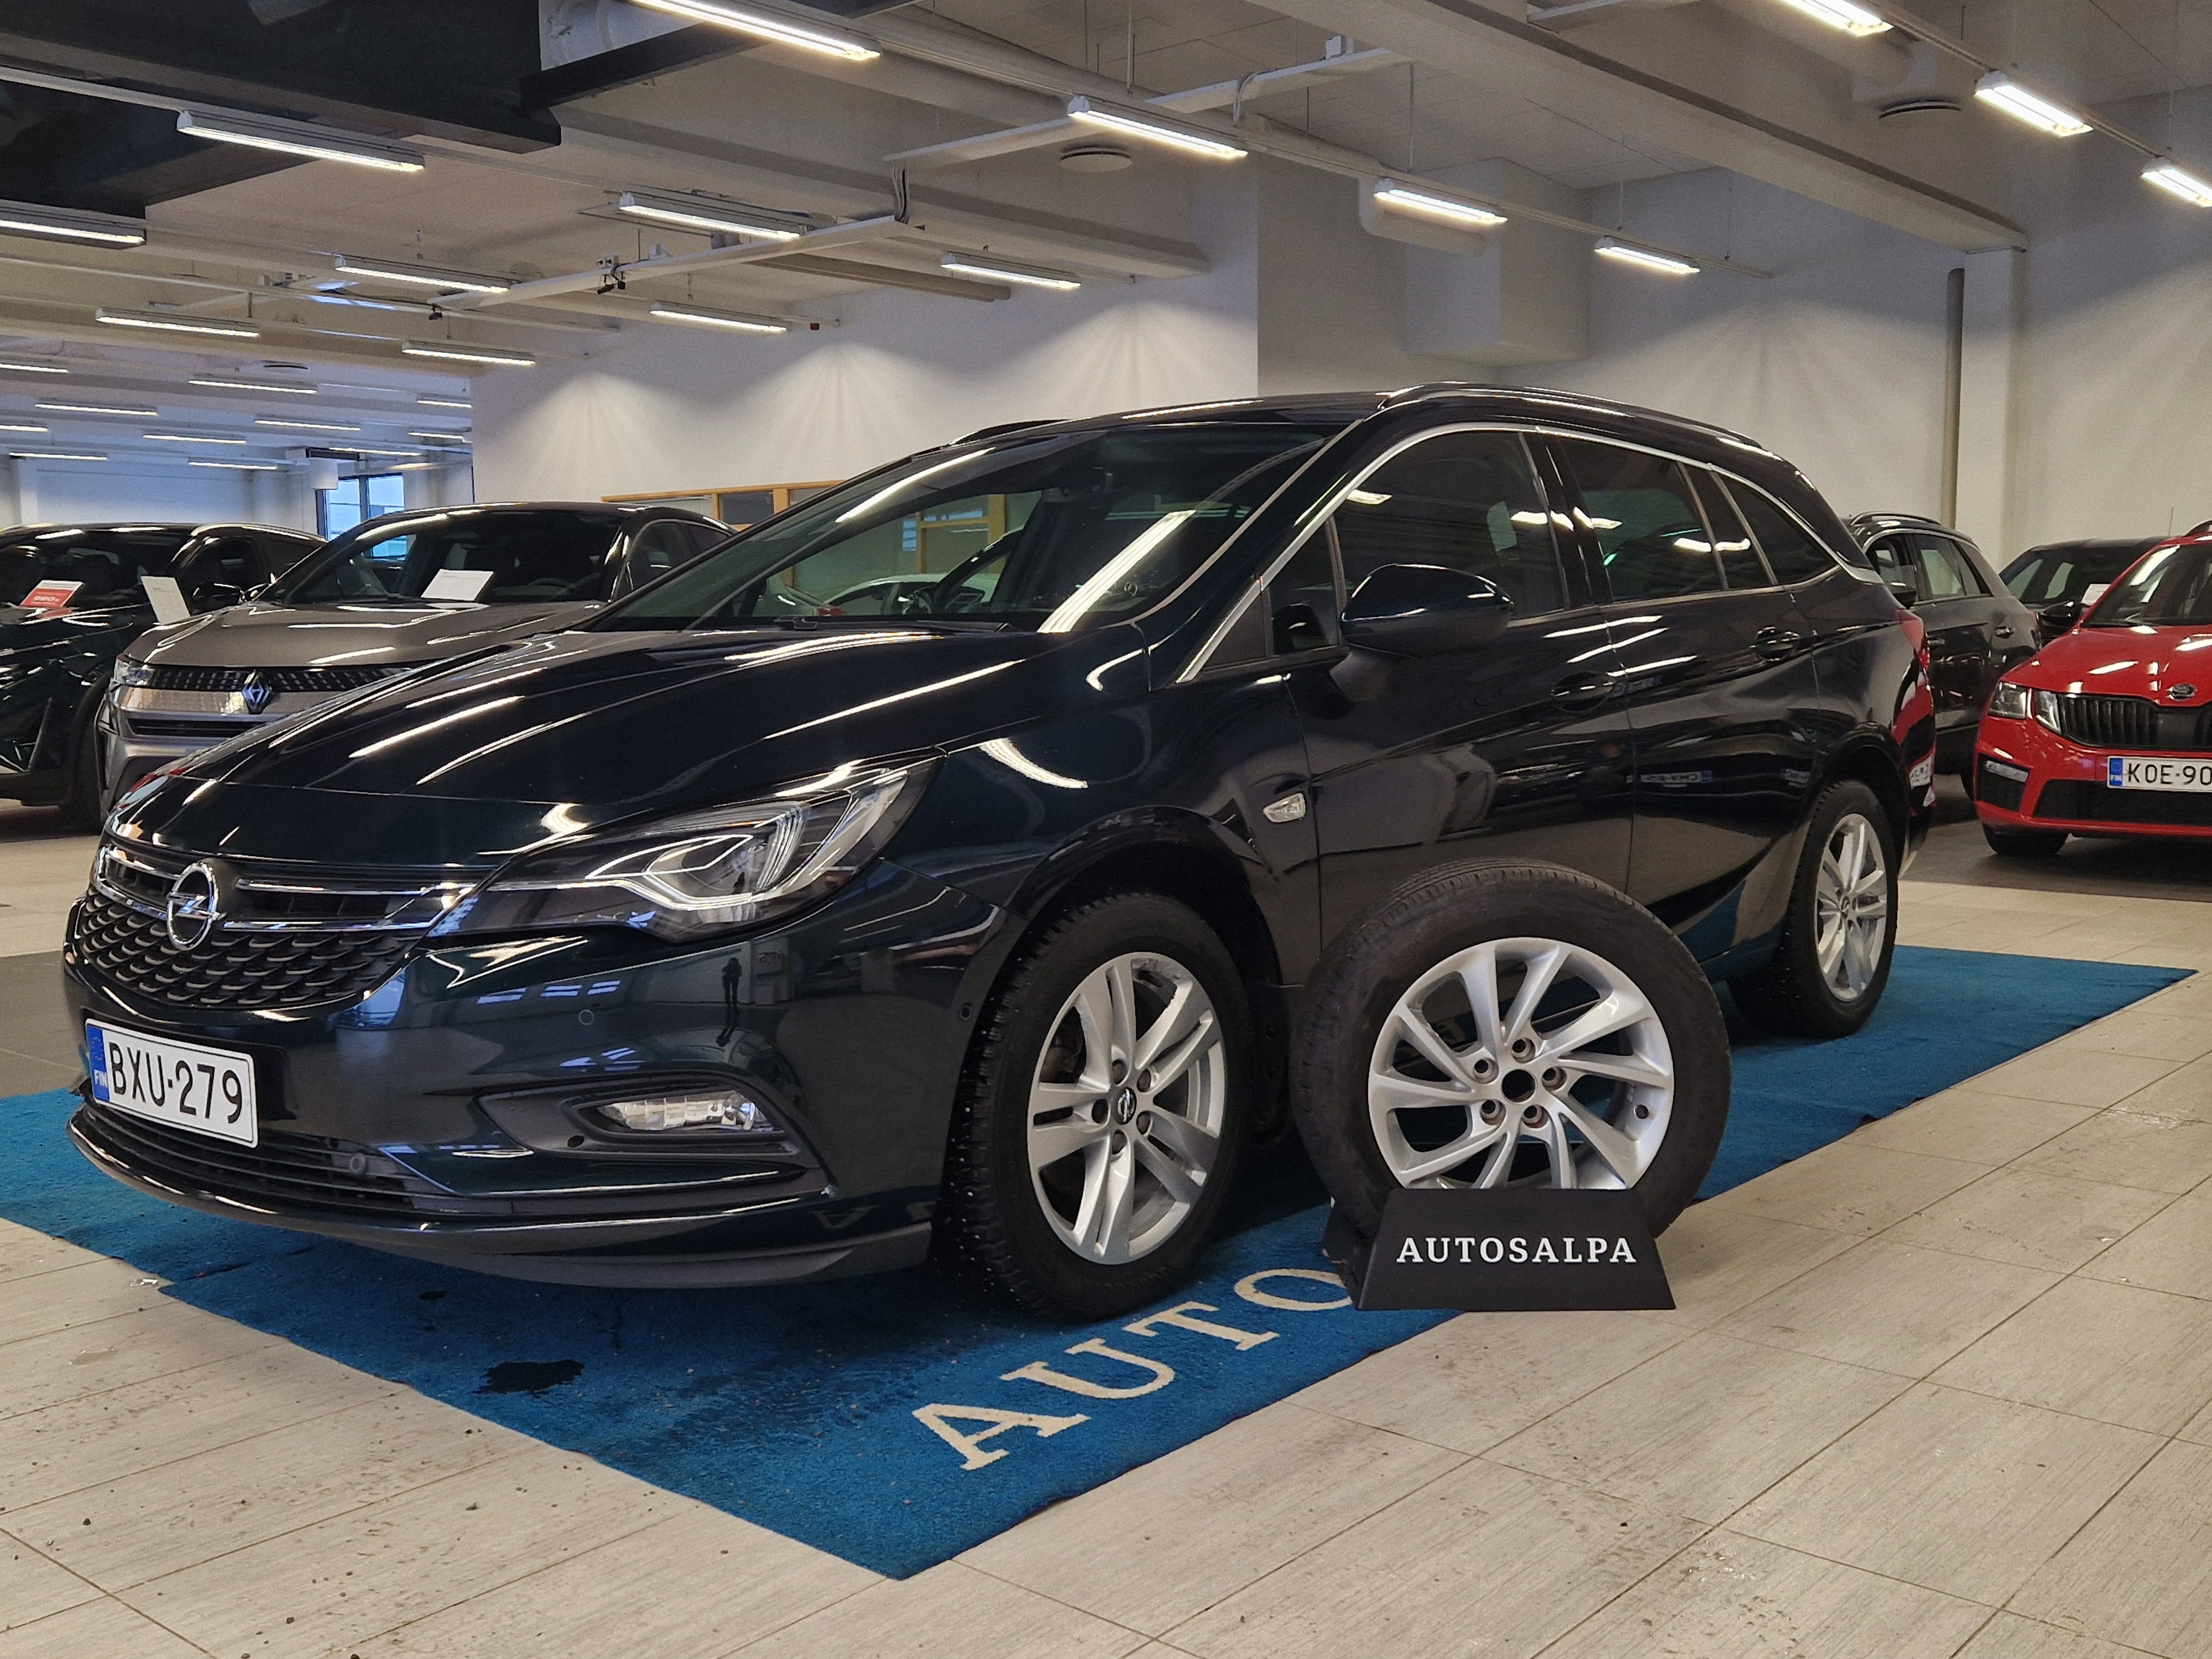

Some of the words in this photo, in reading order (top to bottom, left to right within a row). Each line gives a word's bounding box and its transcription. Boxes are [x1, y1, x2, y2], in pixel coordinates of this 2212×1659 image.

[93, 1068, 108, 1088] FIN
[108, 1041, 242, 1124] BXU-279
[1396, 1237, 1636, 1263] AUTOSALPA
[912, 1267, 1353, 1470] AUTO
